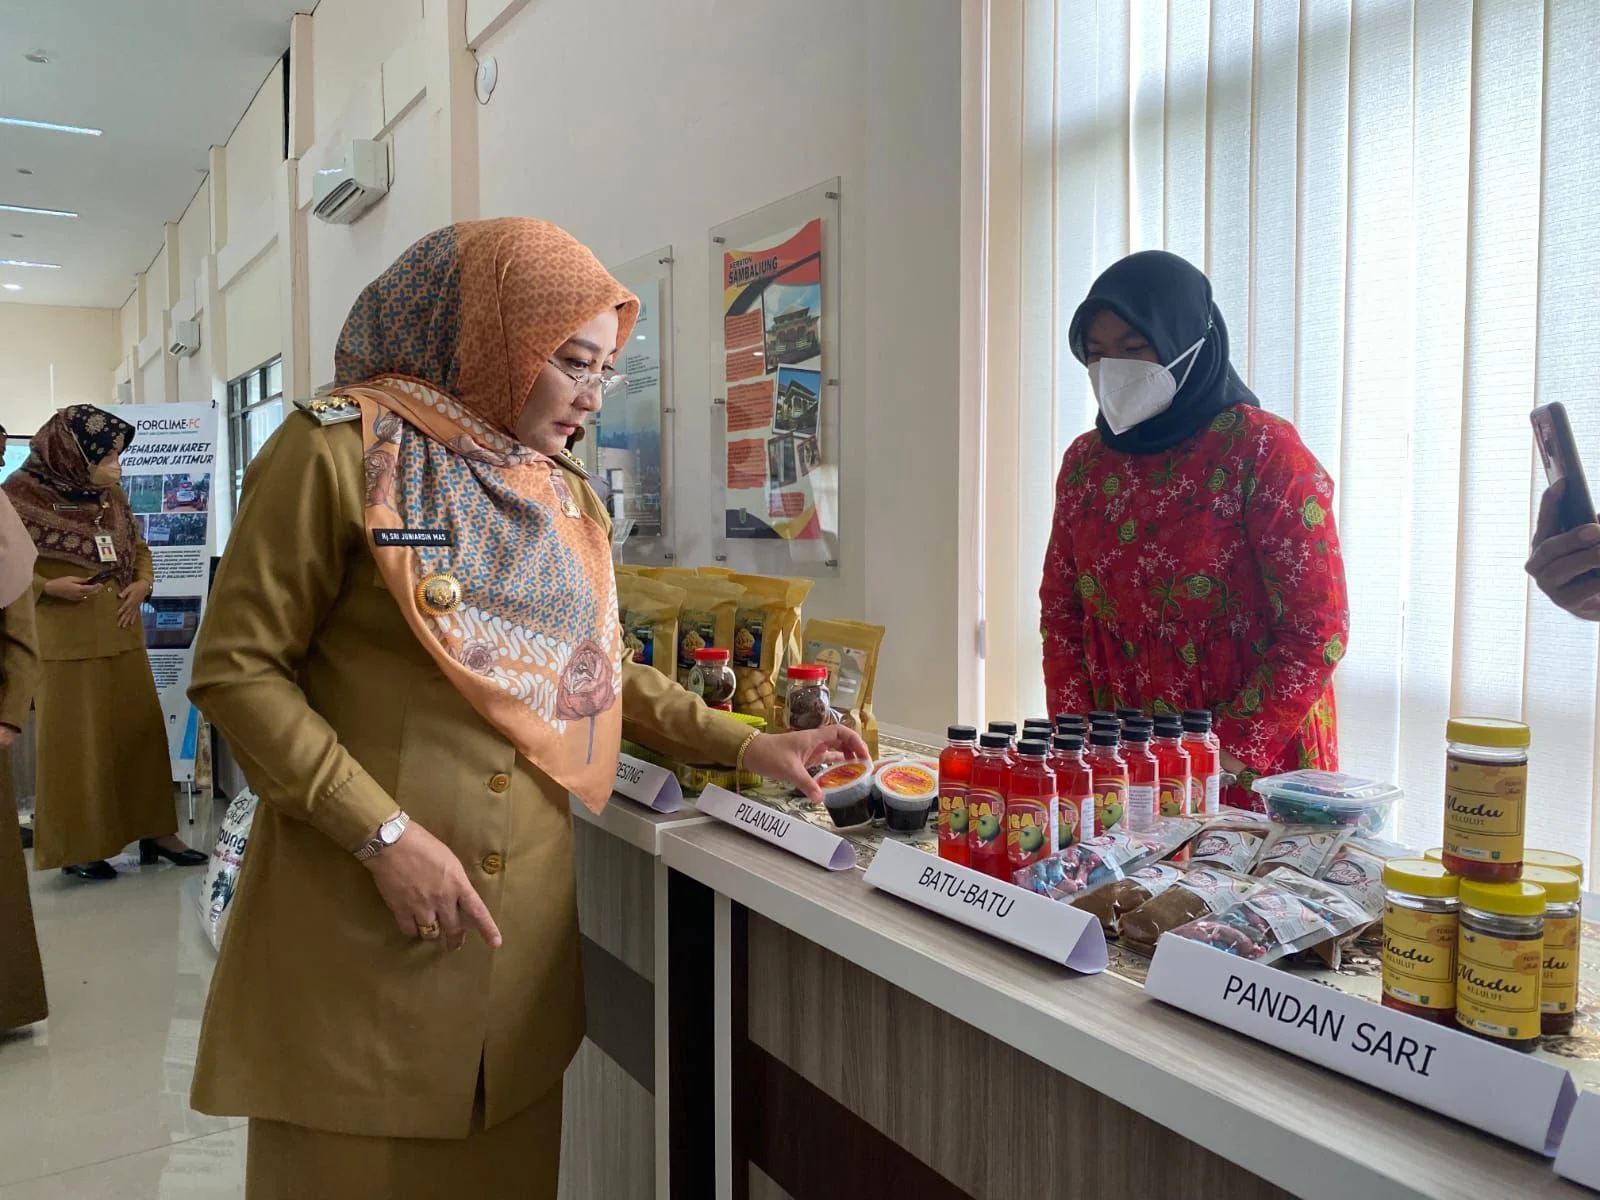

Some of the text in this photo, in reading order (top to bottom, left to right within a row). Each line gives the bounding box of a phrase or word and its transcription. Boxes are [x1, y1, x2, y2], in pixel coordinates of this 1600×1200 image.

[121, 454, 214, 467] KELOMPOK JATIMUR
[125, 442, 211, 454] PEMASARAN KARET
[734, 802, 790, 839] PILANJAU
[918, 866, 1015, 919] BATU-BATU
[1458, 963, 1522, 994] Madu
[1222, 974, 1437, 1078] PANDAN SARI
